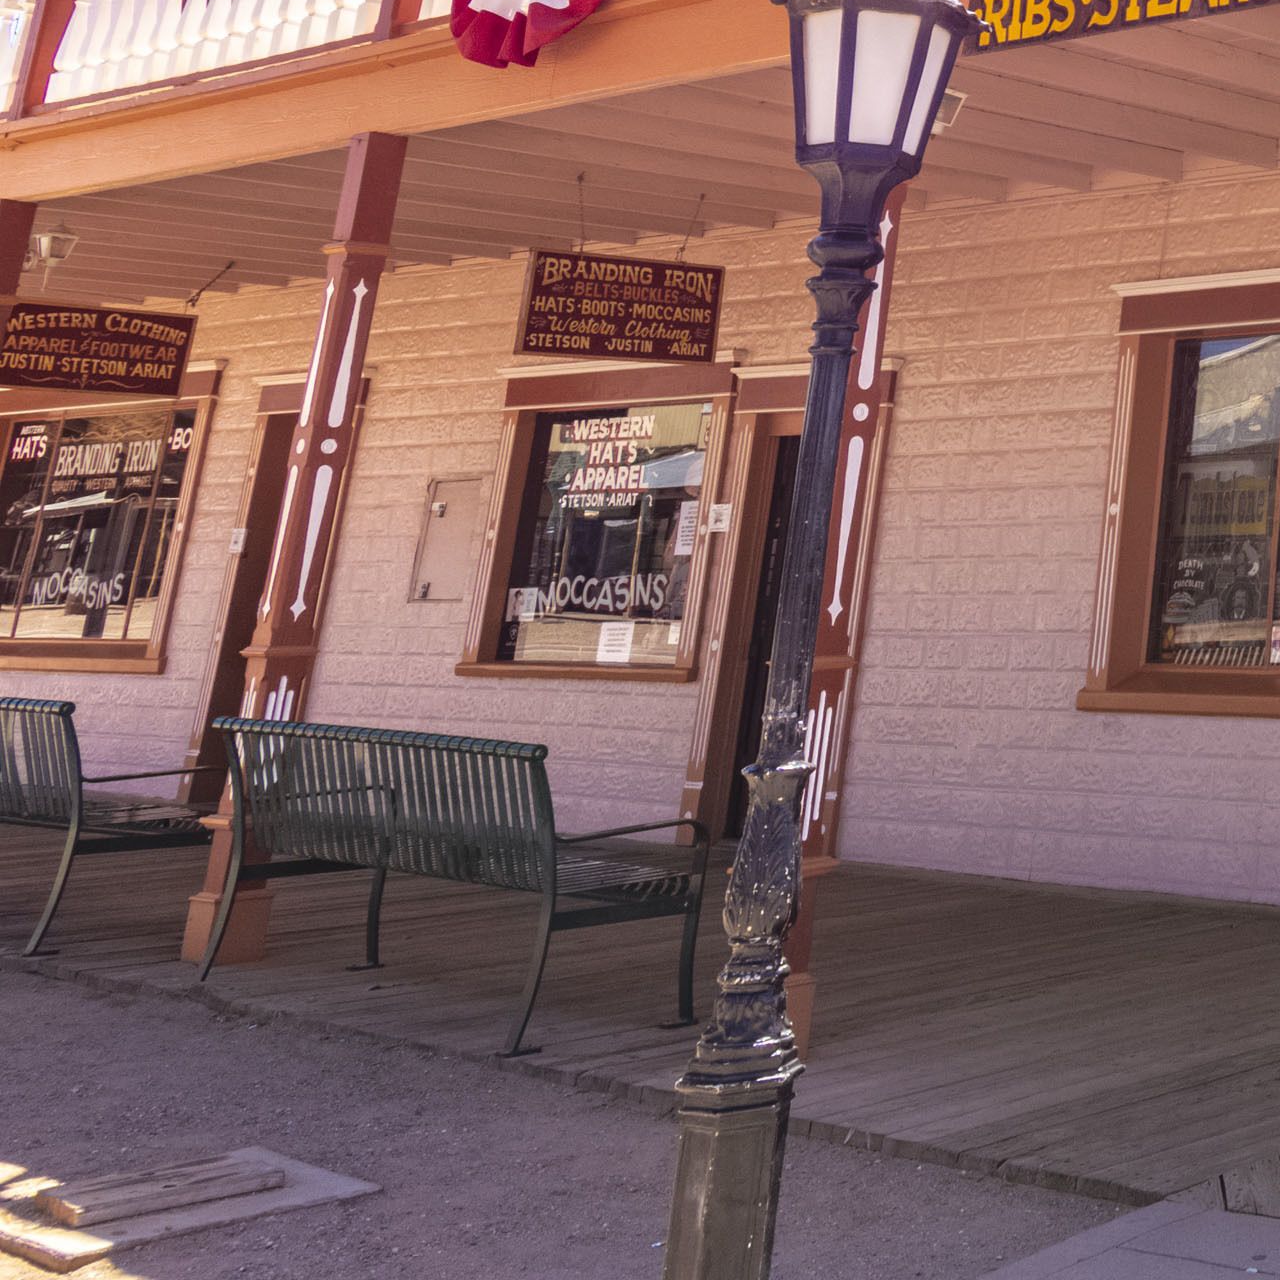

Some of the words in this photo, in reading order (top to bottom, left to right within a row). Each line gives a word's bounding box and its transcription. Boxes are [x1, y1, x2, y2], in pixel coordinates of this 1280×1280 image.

[543, 257, 653, 286] BRANDING
[665, 269, 713, 303] IRON
[574, 282, 619, 298] BELTS
[623, 284, 679, 304] BUCKLES
[534, 296, 575, 313] HATS
[582, 300, 625, 317] BOOTS
[632, 303, 711, 324] MOCCASINS
[7, 312, 98, 332] WESTERN
[105, 313, 187, 346] CLOTHING
[547, 315, 616, 336] Western
[625, 320, 692, 345] Clothing
[4, 335, 79, 354] APPAREL
[90, 341, 178, 362] FOOTWEAR
[529, 333, 590, 349] STETSON
[607, 338, 653, 353] JUSTIN
[670, 343, 707, 356] ARIAT
[0, 352, 54, 371] JUSTIN
[61, 357, 128, 377] STETSON
[131, 364, 176, 380] ARIAT
[573, 416, 655, 441] WESTERN
[11, 435, 48, 459] HATS
[54, 442, 122, 476] BRANDING
[124, 439, 162, 472] IRON
[588, 442, 637, 465] HATS
[570, 465, 649, 491] APPAREL
[560, 493, 604, 508] STETSON
[608, 493, 638, 507] ARIAT
[1179, 559, 1204, 570] DEATH
[32, 566, 125, 609] MOCCASINS
[538, 573, 668, 619] MOCCASINS
[1173, 580, 1205, 590] CHOCOLATE
